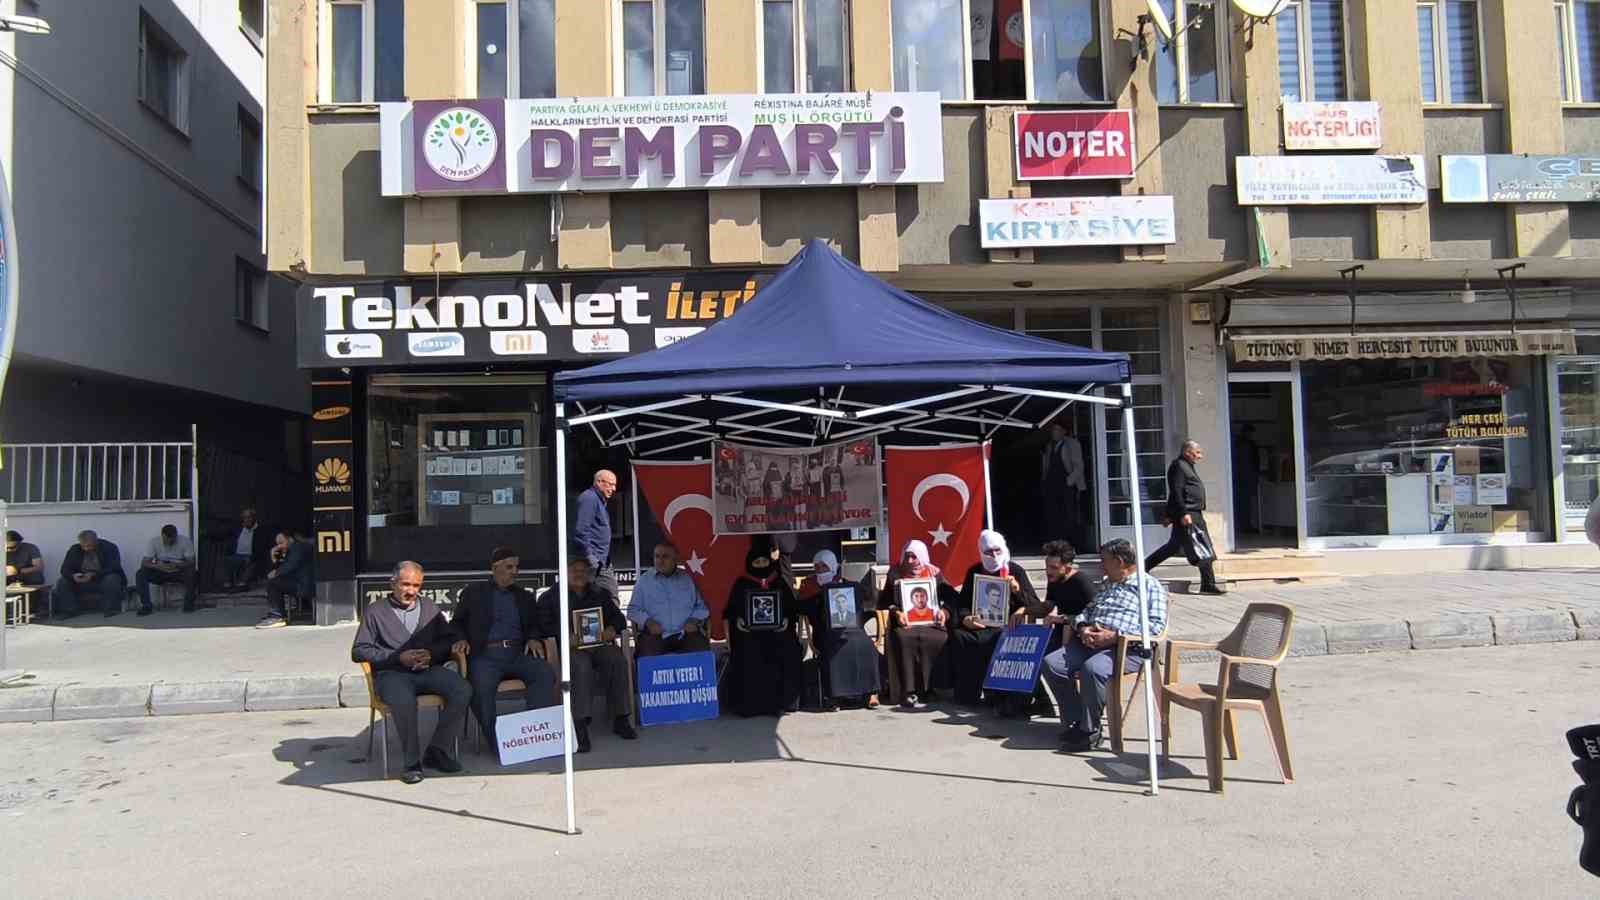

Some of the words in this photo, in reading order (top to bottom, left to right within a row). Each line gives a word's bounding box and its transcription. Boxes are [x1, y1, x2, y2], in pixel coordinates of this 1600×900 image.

[622, 116, 635, 125] VE
[530, 126, 676, 180] DEM
[699, 105, 907, 177] PARTİ
[1024, 130, 1127, 158] NOTER
[313, 282, 652, 331] TeknoNet
[1464, 337, 1519, 353] BULUNUR
[315, 485, 351, 493] HUAWEI
[652, 668, 675, 685] ARTIK
[675, 666, 698, 683] YETER
[640, 688, 690, 709] YAKAMIZDAN
[521, 721, 551, 734] EVLAT
